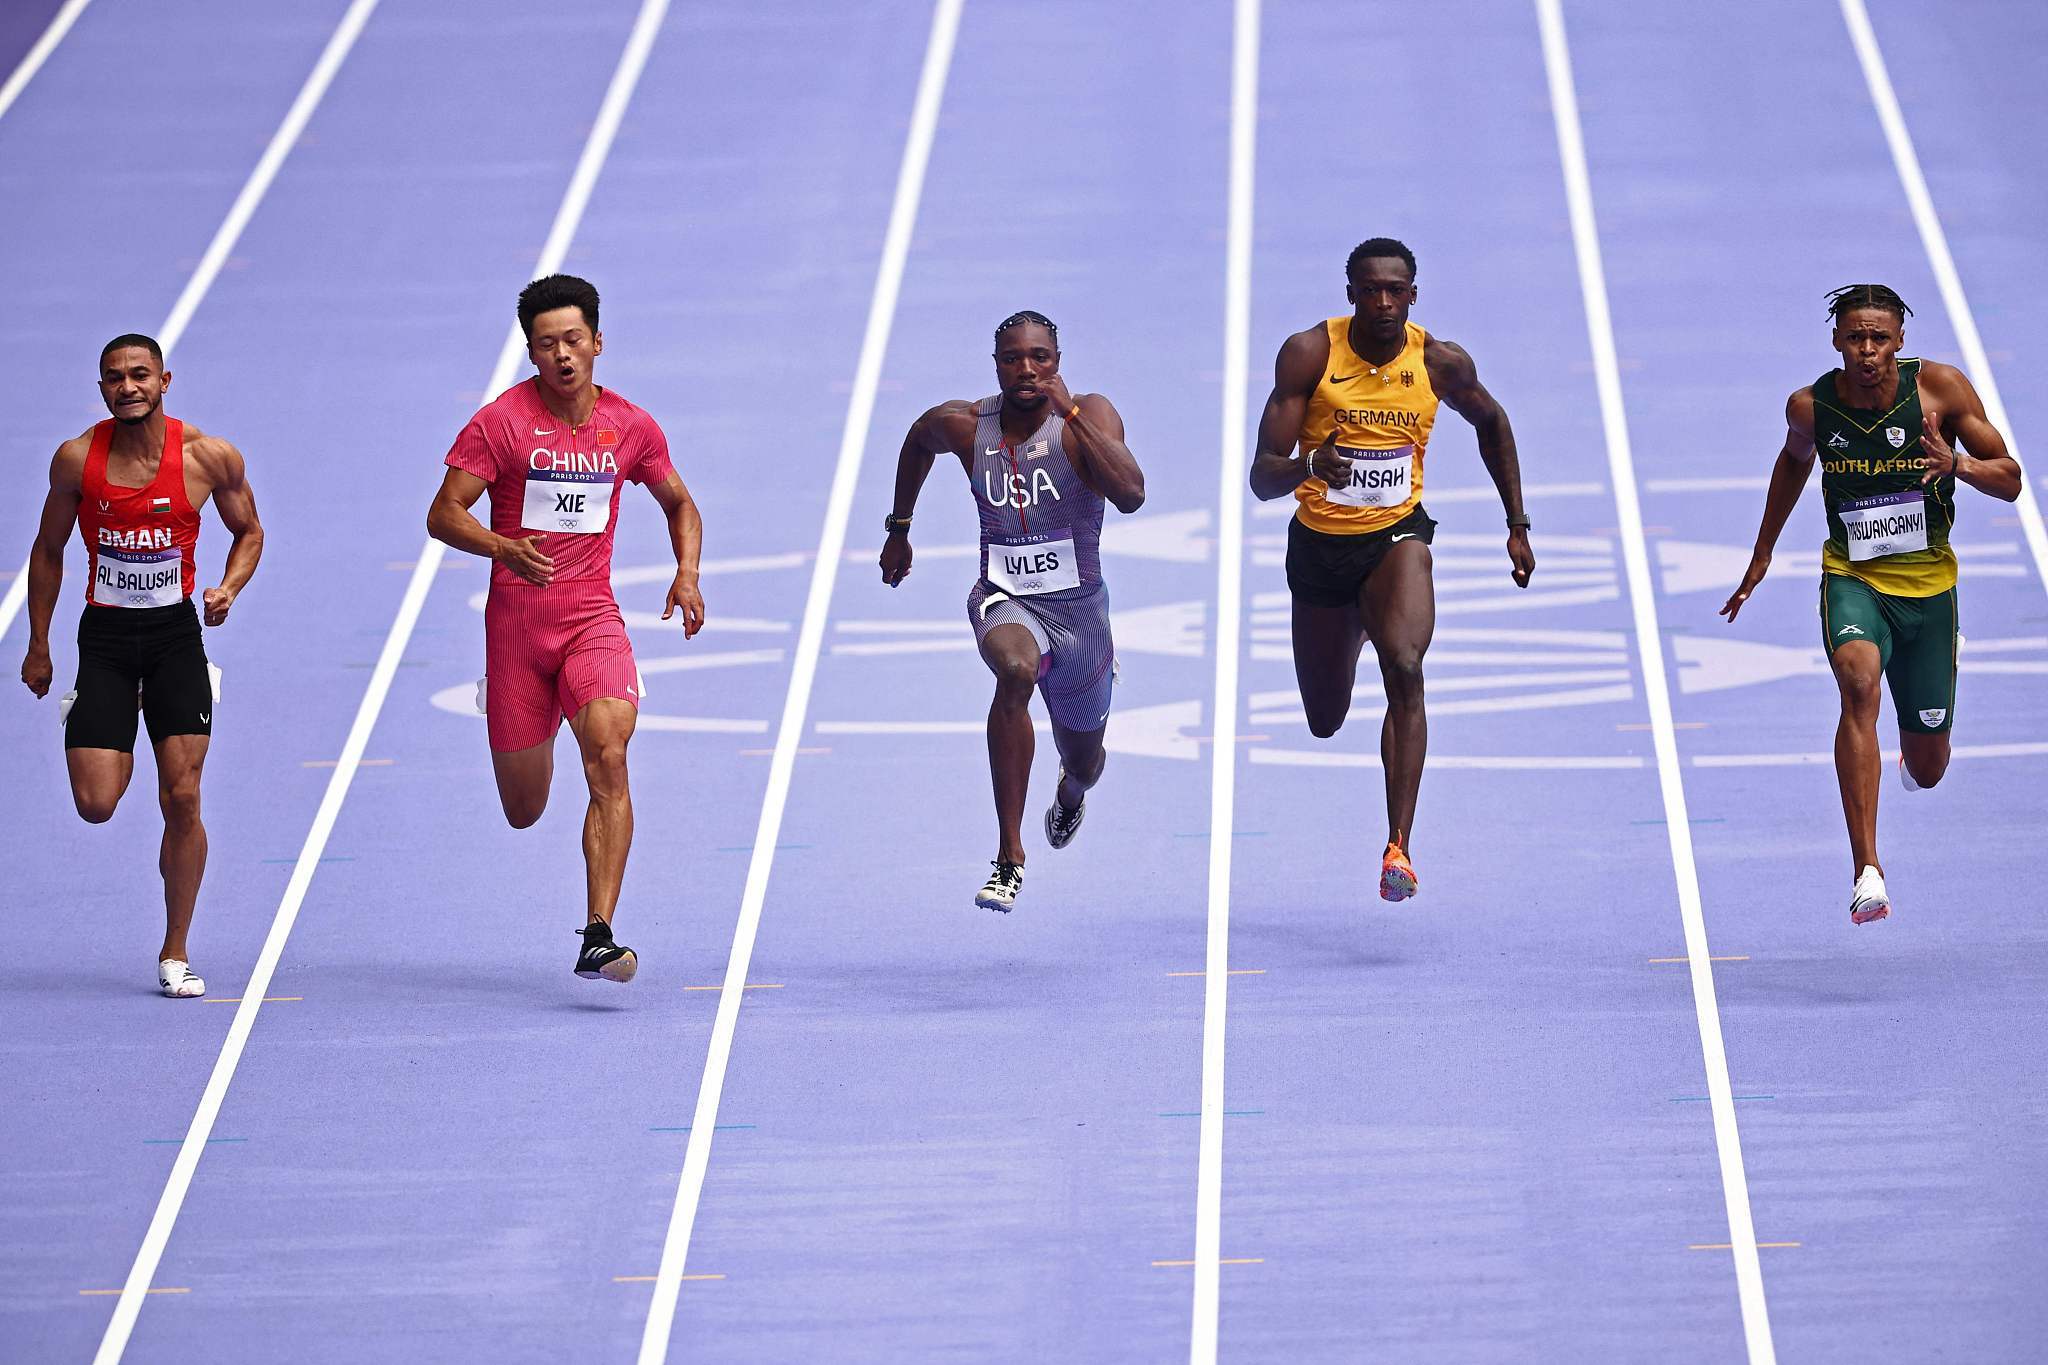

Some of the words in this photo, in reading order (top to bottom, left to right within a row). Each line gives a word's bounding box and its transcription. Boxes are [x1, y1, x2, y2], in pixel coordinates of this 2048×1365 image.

[1334, 409, 1420, 427] GERMANY
[529, 448, 618, 474] CHINA
[1353, 450, 1376, 458] PARIS
[1377, 450, 1396, 458] 2024
[1822, 459, 1869, 473] OUTH
[1873, 457, 1929, 473] AFRIC
[550, 472, 573, 480] PARIS
[1347, 466, 1404, 489] NSAH
[985, 468, 1061, 509] USA
[554, 493, 586, 513] XIE
[1855, 498, 1877, 508] PARIS
[1879, 496, 1900, 504] 2024
[1846, 513, 1924, 541] MASWANGANYI
[98, 527, 172, 550] OMAN
[1005, 536, 1026, 544] PARIS
[1027, 535, 1049, 543] 2024
[117, 553, 140, 561] PARIS
[1004, 552, 1060, 576] LYLES
[97, 565, 113, 587] AL
[117, 567, 178, 591] BALUSHI
